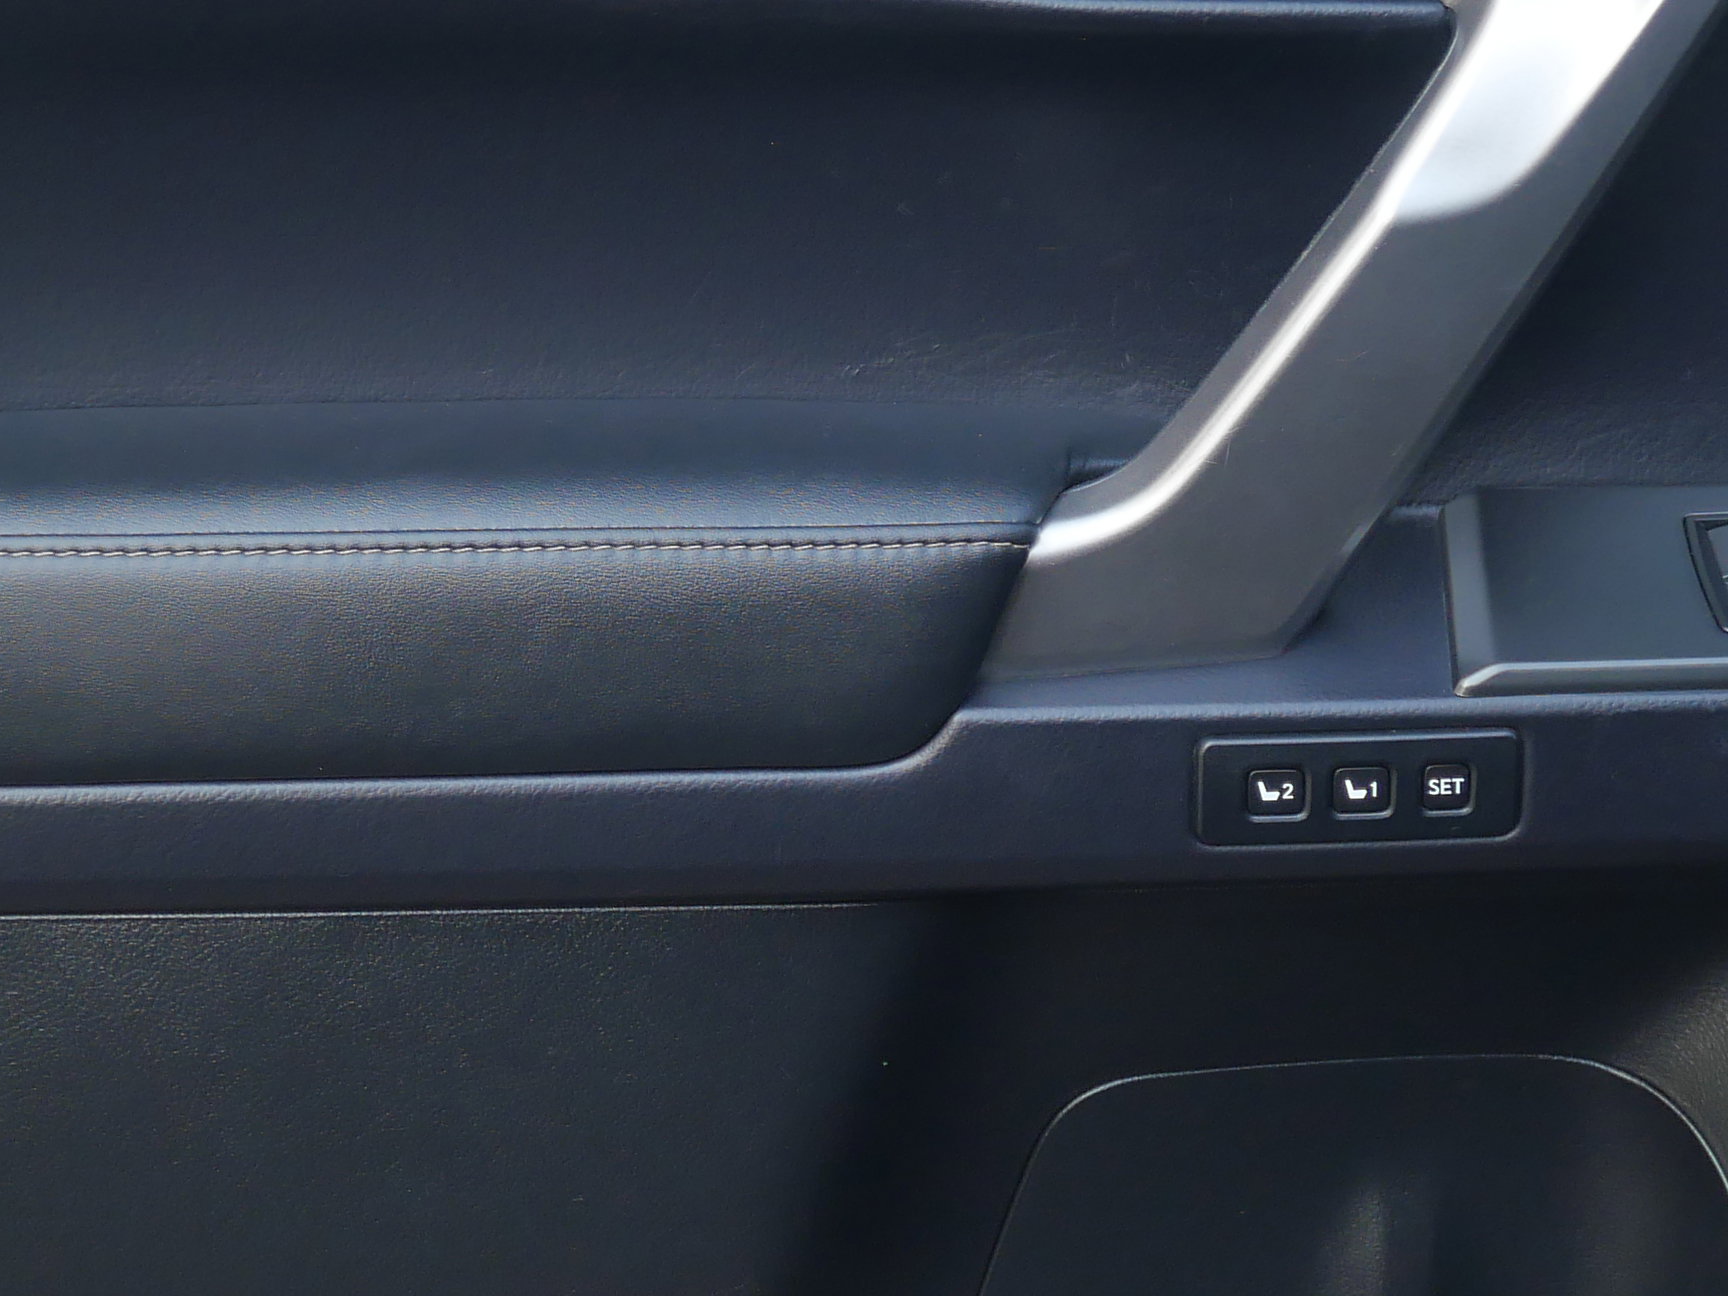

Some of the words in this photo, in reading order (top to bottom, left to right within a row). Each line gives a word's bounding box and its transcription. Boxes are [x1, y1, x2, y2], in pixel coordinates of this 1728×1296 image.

[1282, 783, 1294, 800] 2
[1370, 781, 1379, 798] 1
[1428, 777, 1465, 797] SET
